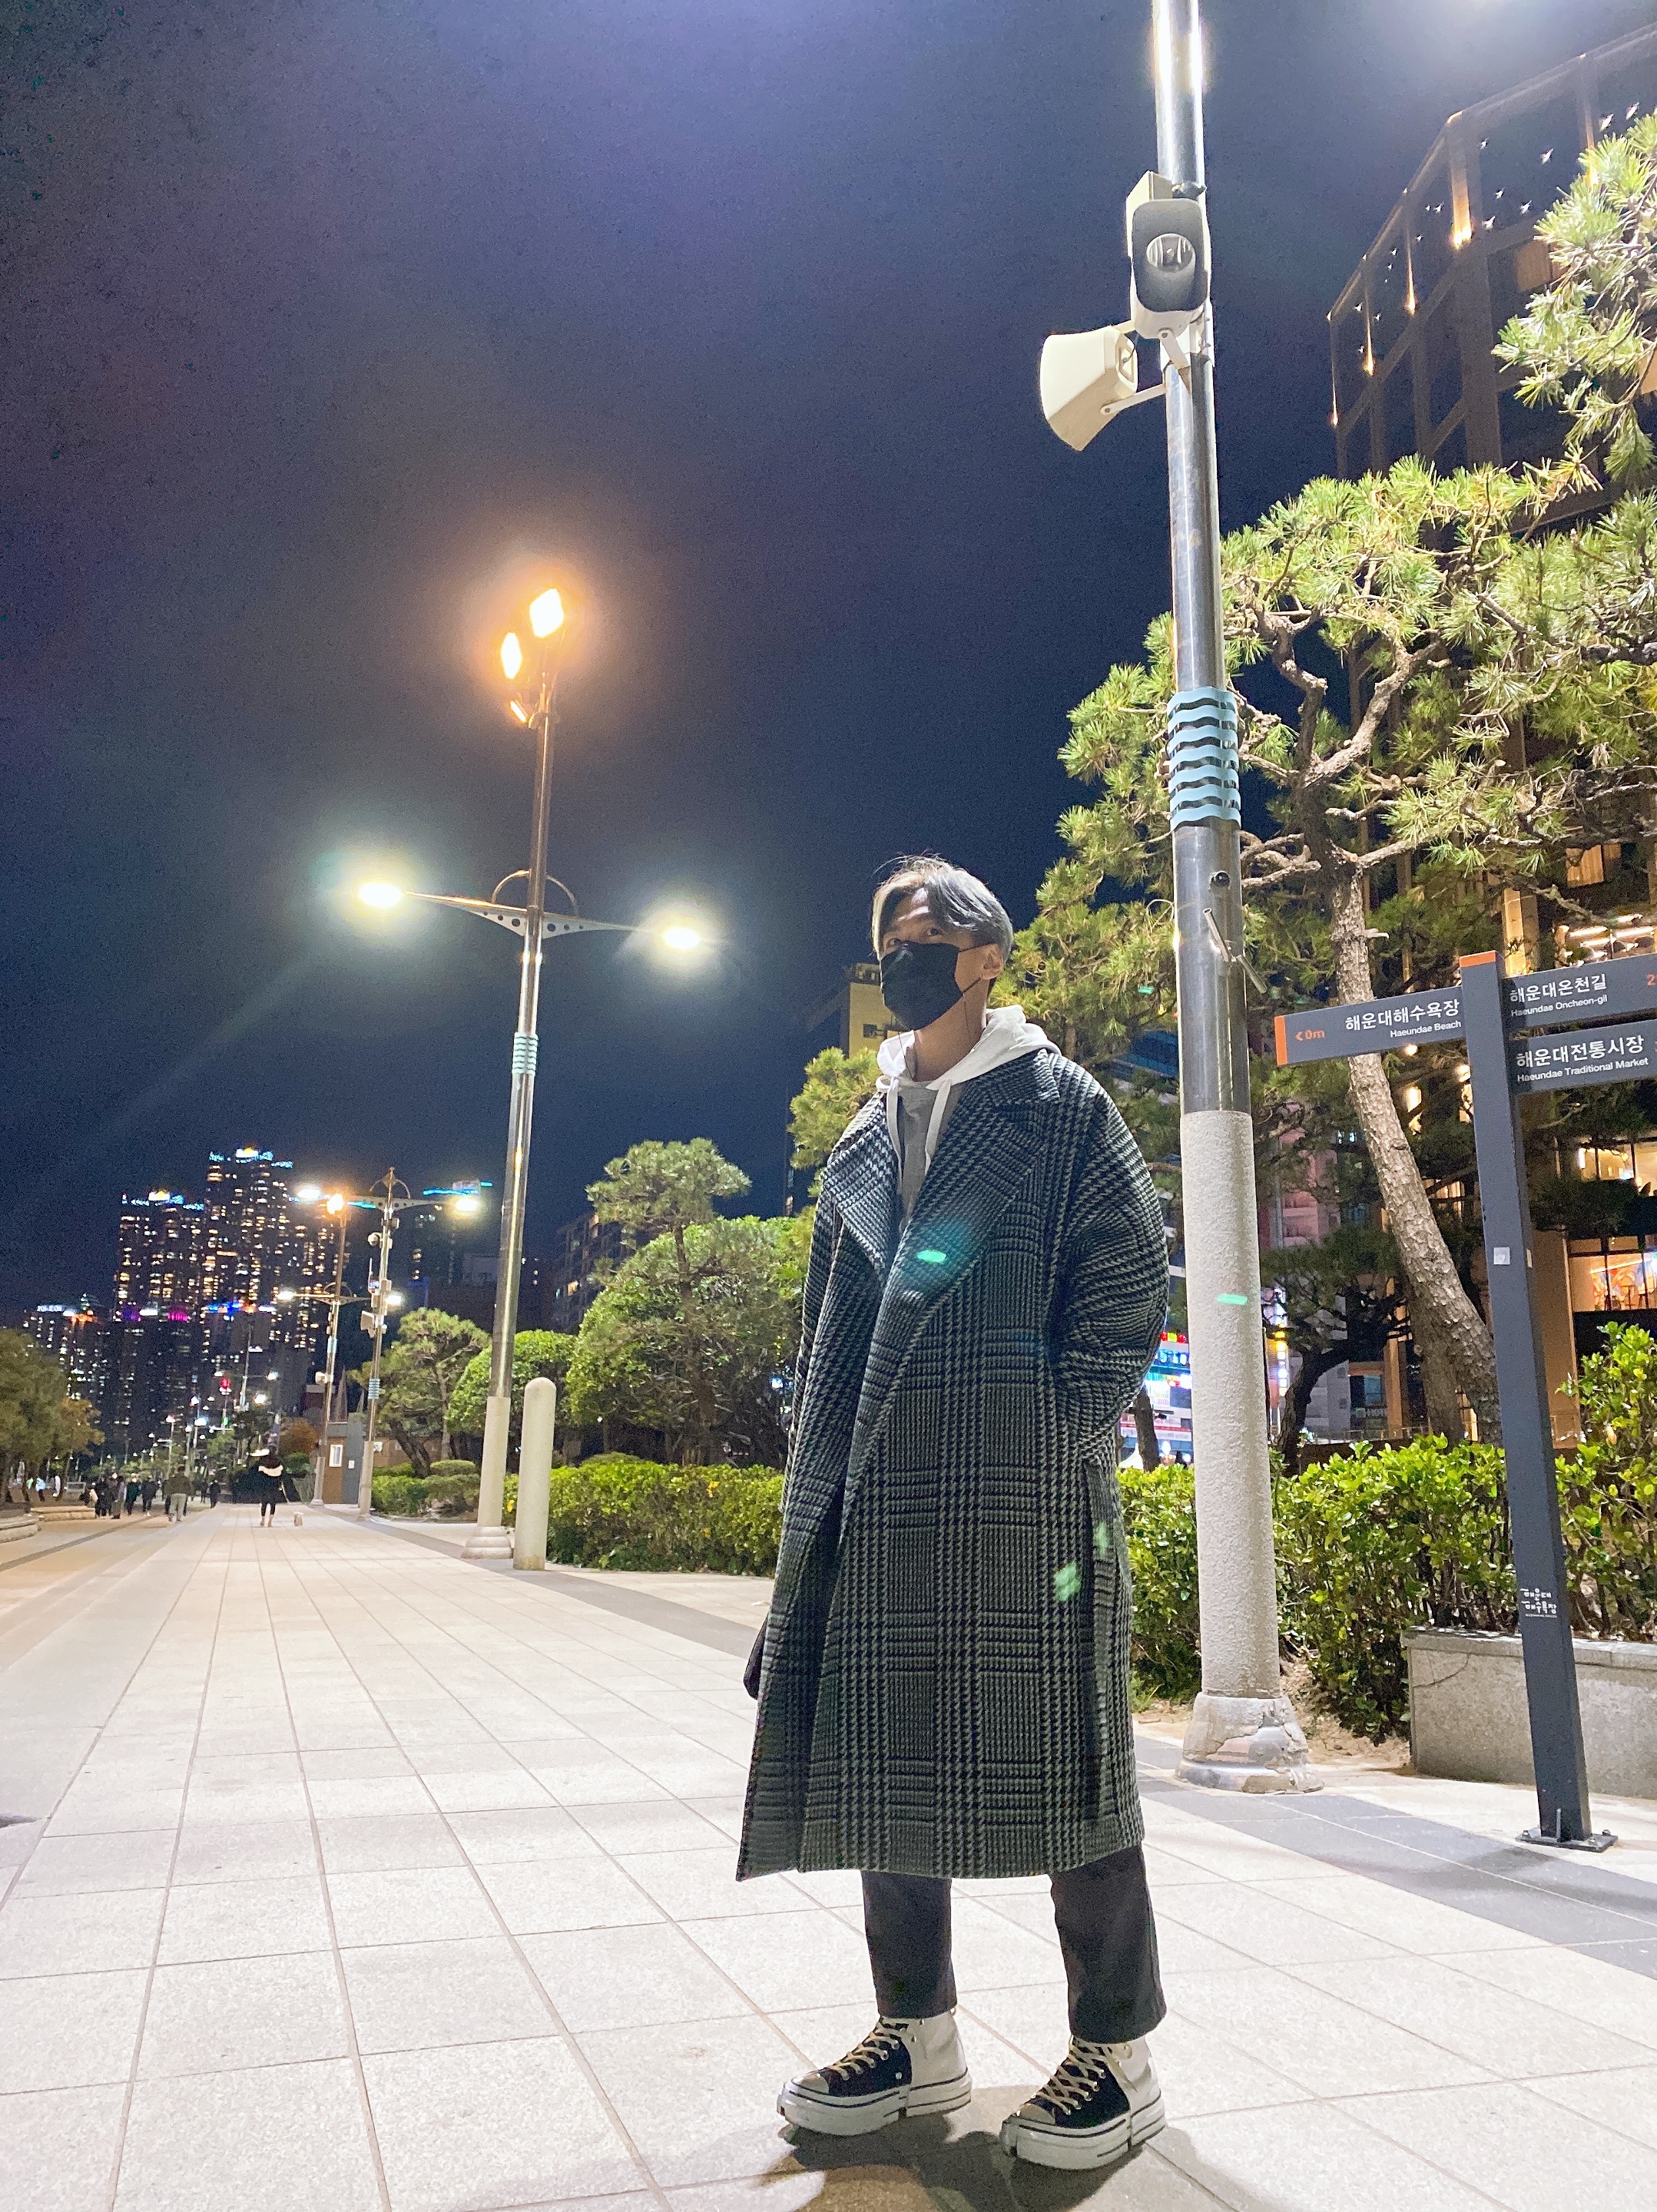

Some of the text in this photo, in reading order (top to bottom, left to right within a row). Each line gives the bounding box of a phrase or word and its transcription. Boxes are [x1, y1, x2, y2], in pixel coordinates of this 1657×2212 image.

[1510, 973, 1607, 1003] 해운대온천길
[1345, 998, 1460, 1031] 해운대해수욕장
[1511, 994, 1608, 1017] Haeundae Oncheon-gil
[1390, 1020, 1462, 1038] Haeundae Beach
[1516, 1035, 1645, 1068] 해운대전통시장
[1517, 1057, 1649, 1082] Haeundae Traditional Market
